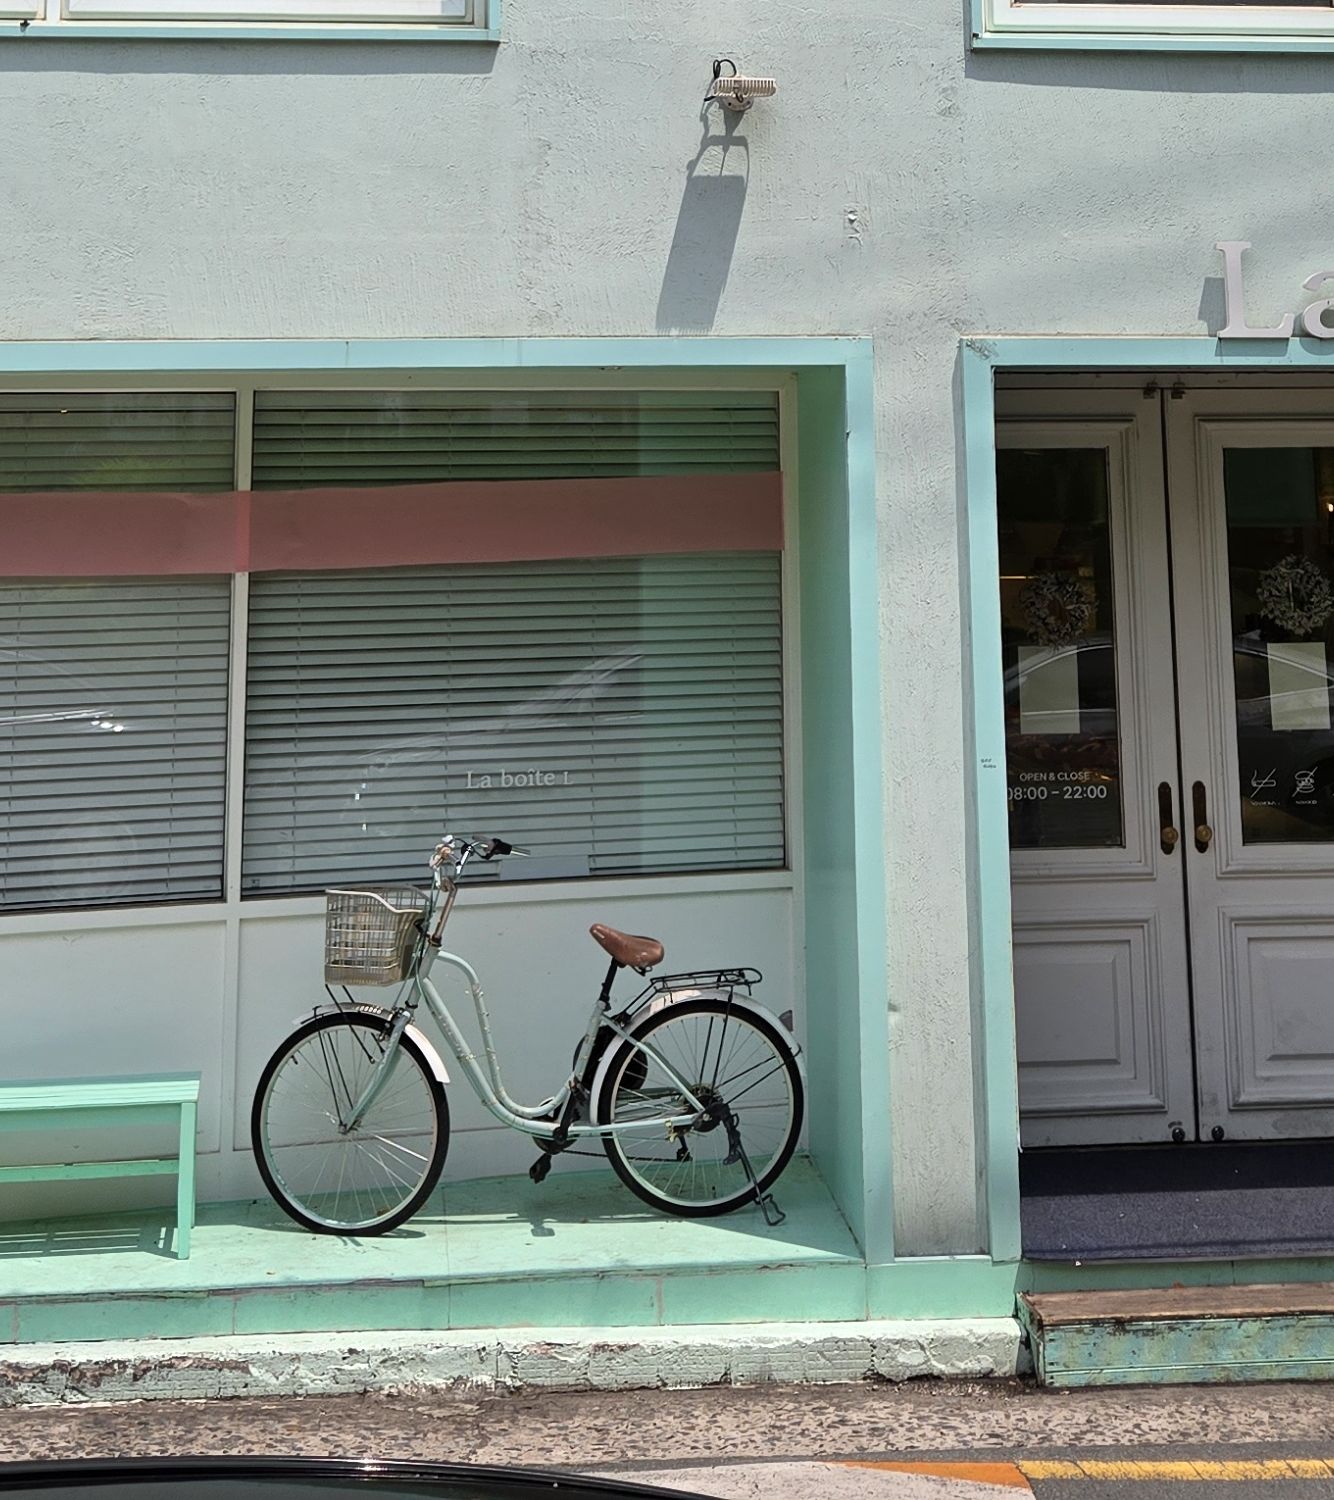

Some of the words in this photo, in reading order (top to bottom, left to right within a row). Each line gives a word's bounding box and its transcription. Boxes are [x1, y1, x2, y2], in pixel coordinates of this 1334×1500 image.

[465, 770, 493, 788] La
[500, 767, 556, 787] boîte
[563, 771, 574, 785] L
[1019, 772, 1047, 781] OPEN
[1048, 772, 1055, 781] &
[1057, 771, 1090, 781] CLOSE
[1063, 785, 1107, 799] 22:00
